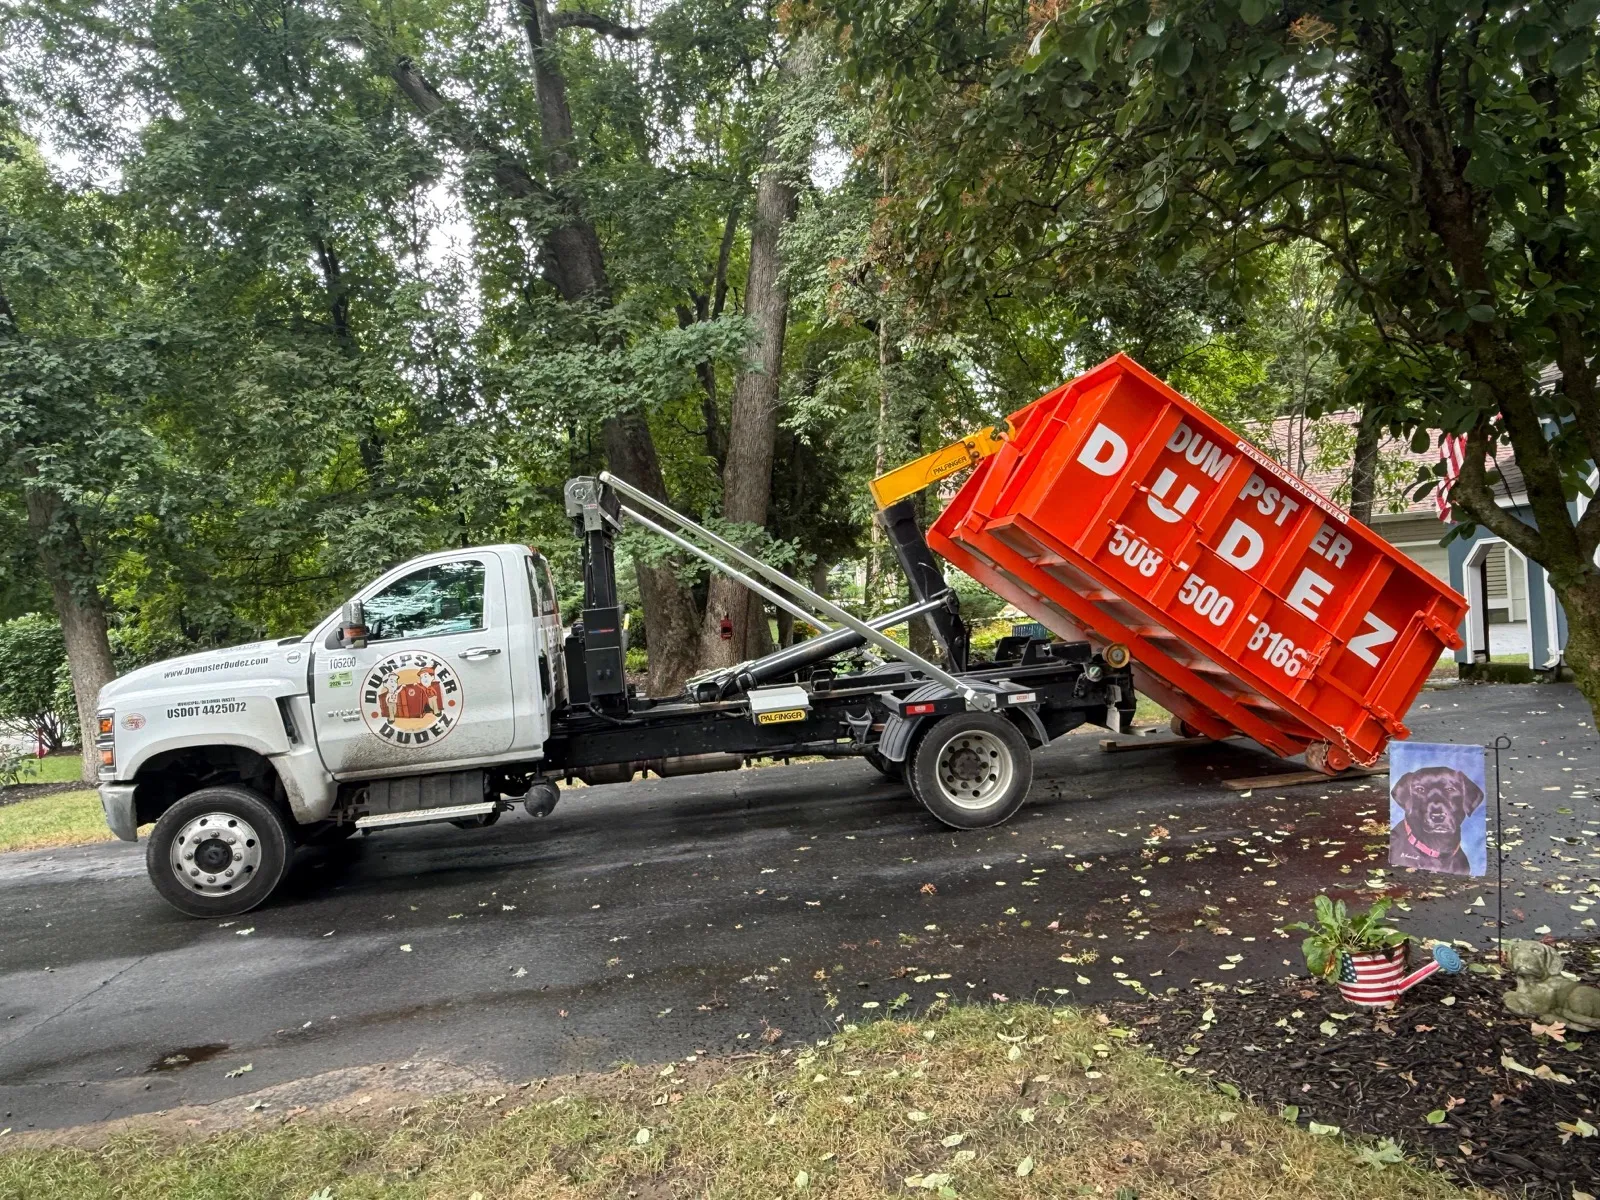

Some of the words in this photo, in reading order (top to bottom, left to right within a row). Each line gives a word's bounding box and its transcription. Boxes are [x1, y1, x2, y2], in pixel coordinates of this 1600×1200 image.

[932, 455, 968, 476] PALFINGER
[1241, 445, 1287, 480] MAXIMUM
[1288, 478, 1312, 498] LOAD
[163, 657, 269, 679] www.DumpsterDudez.com
[329, 656, 357, 670] 105200
[364, 654, 458, 704] DUMPSTER
[166, 706, 201, 719] USDOT
[202, 701, 247, 715] 4425072
[760, 711, 803, 722] PALFINGER
[378, 713, 454, 745] DUDEZ
